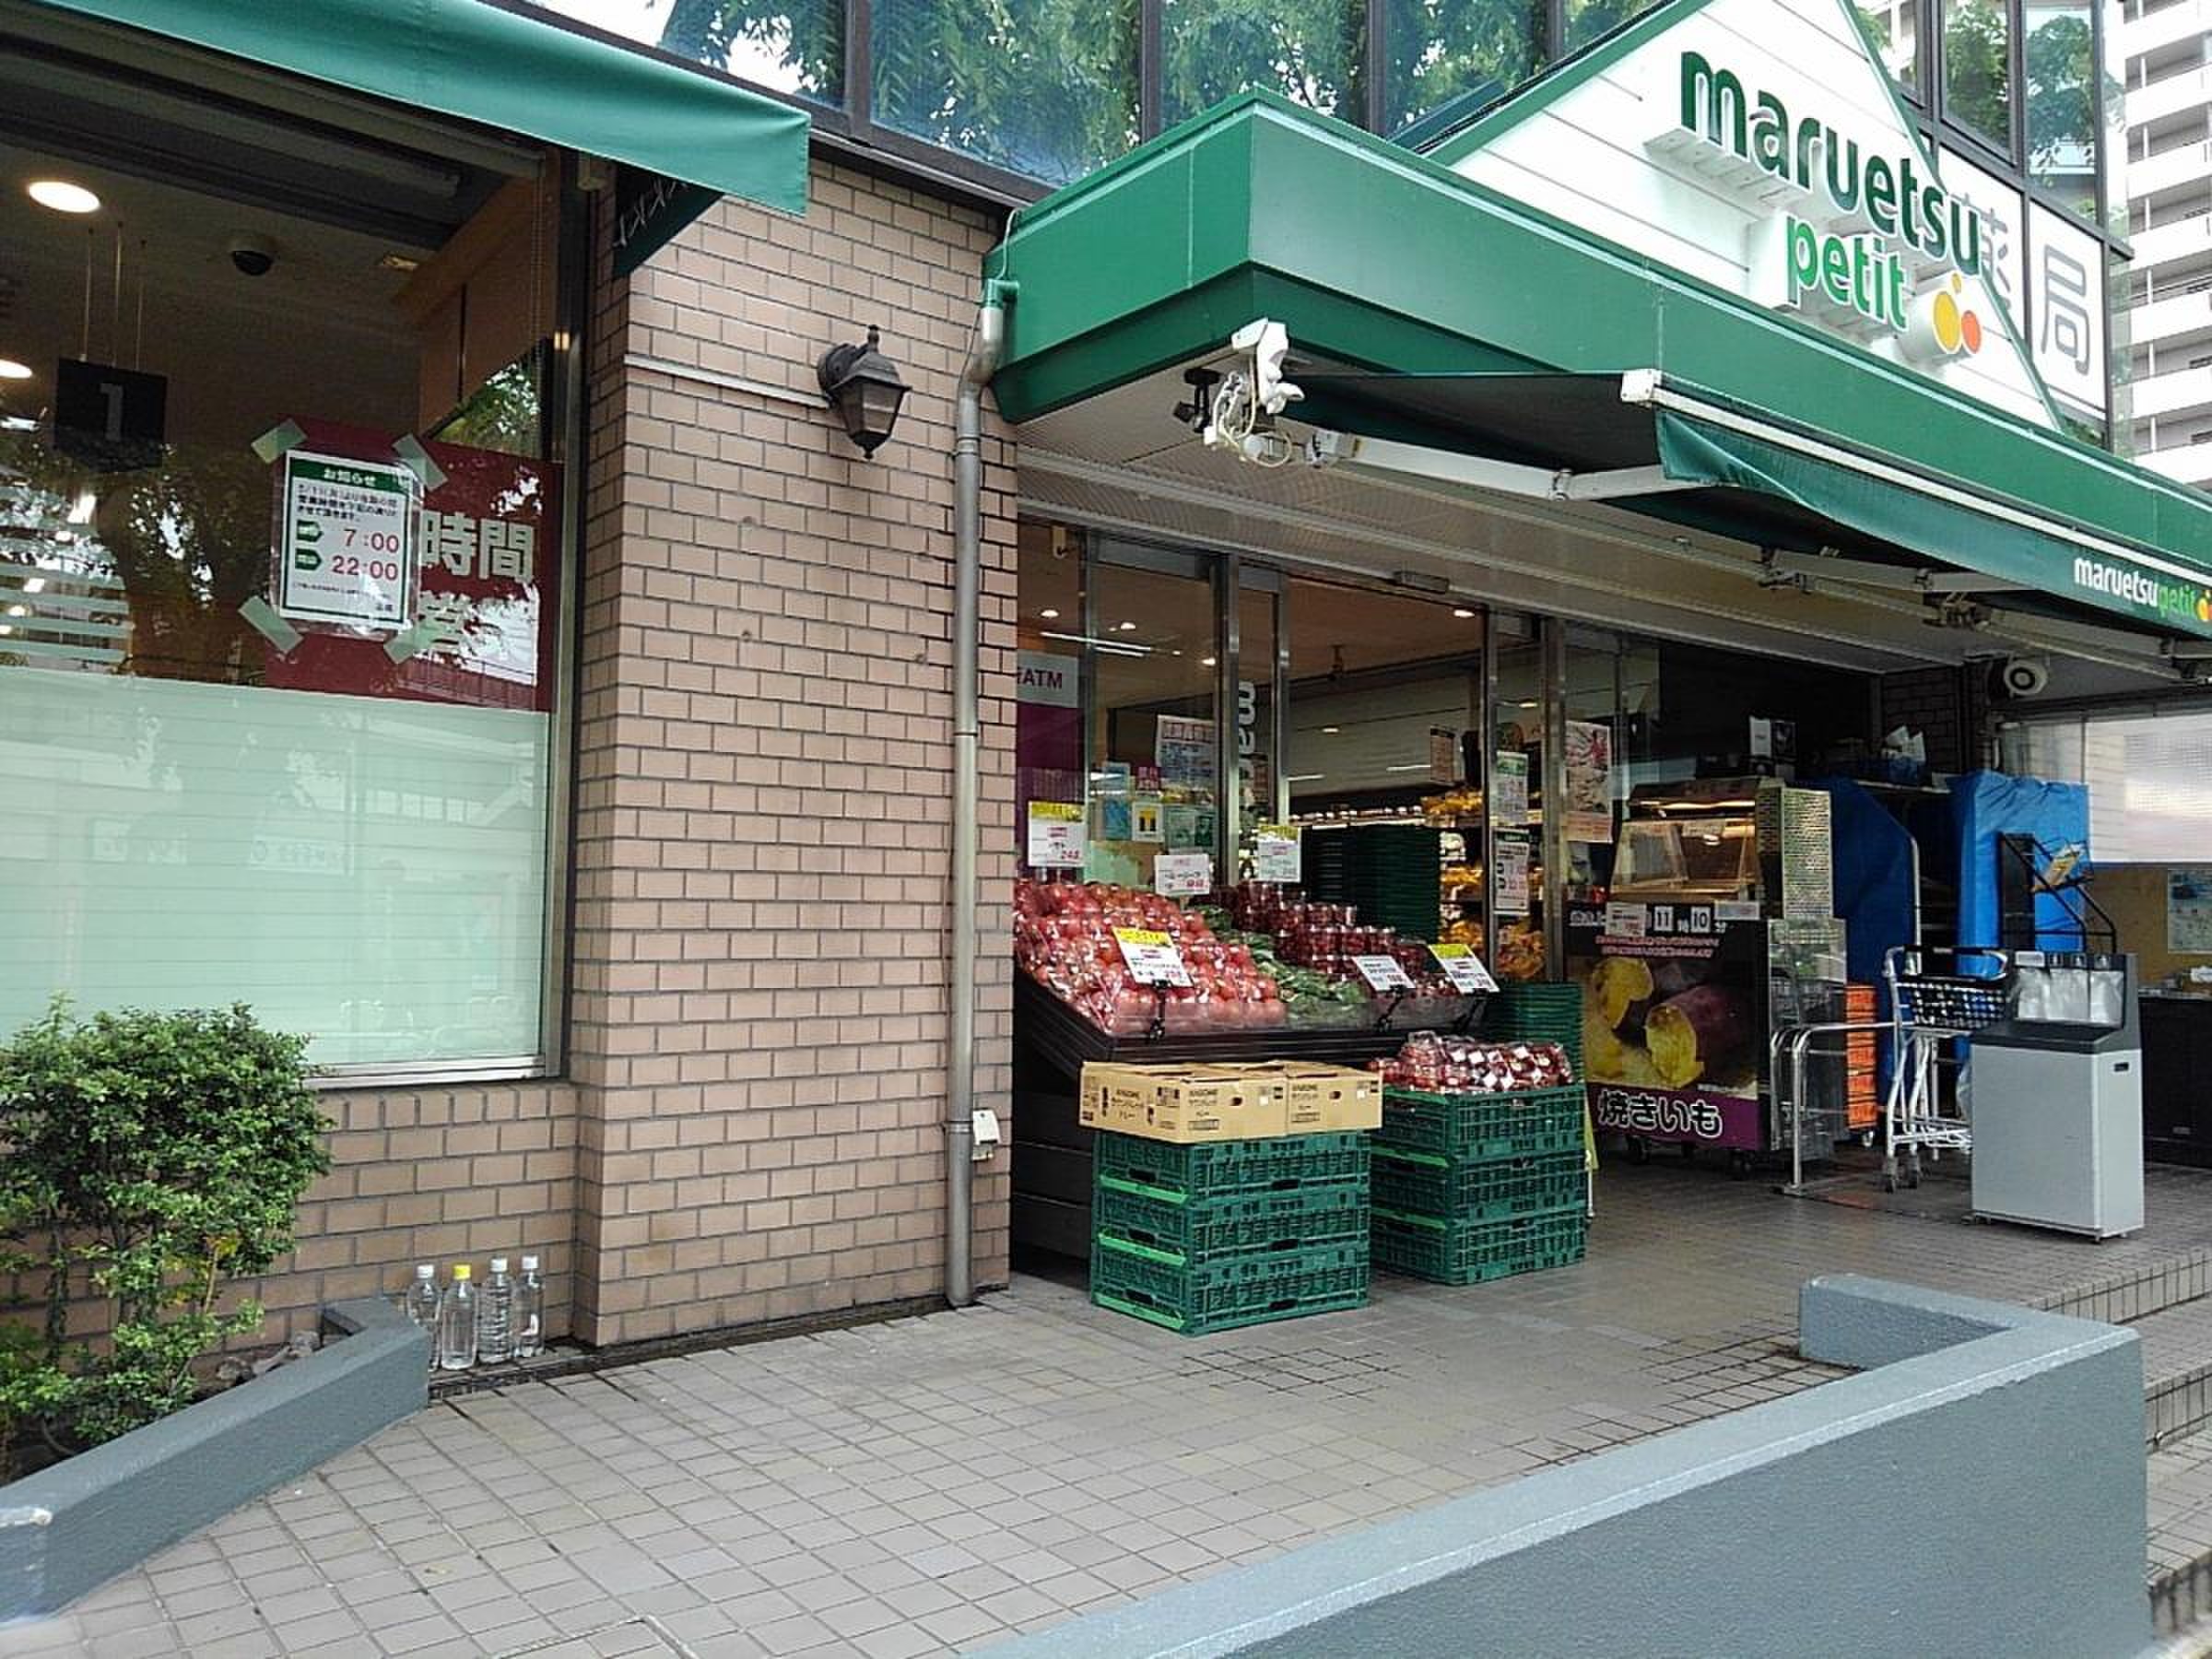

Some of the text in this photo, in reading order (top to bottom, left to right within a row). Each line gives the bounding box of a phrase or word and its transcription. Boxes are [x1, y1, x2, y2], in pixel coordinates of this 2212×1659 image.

[1680, 51, 1982, 276] maruetsu
[1787, 215, 1907, 328] petit
[100, 382, 124, 442] 1
[332, 555, 399, 581] 22:00
[2074, 557, 2159, 607] maruetsu
[1692, 912, 1709, 929] 10
[1598, 1088, 1723, 1138] 焼きいも
